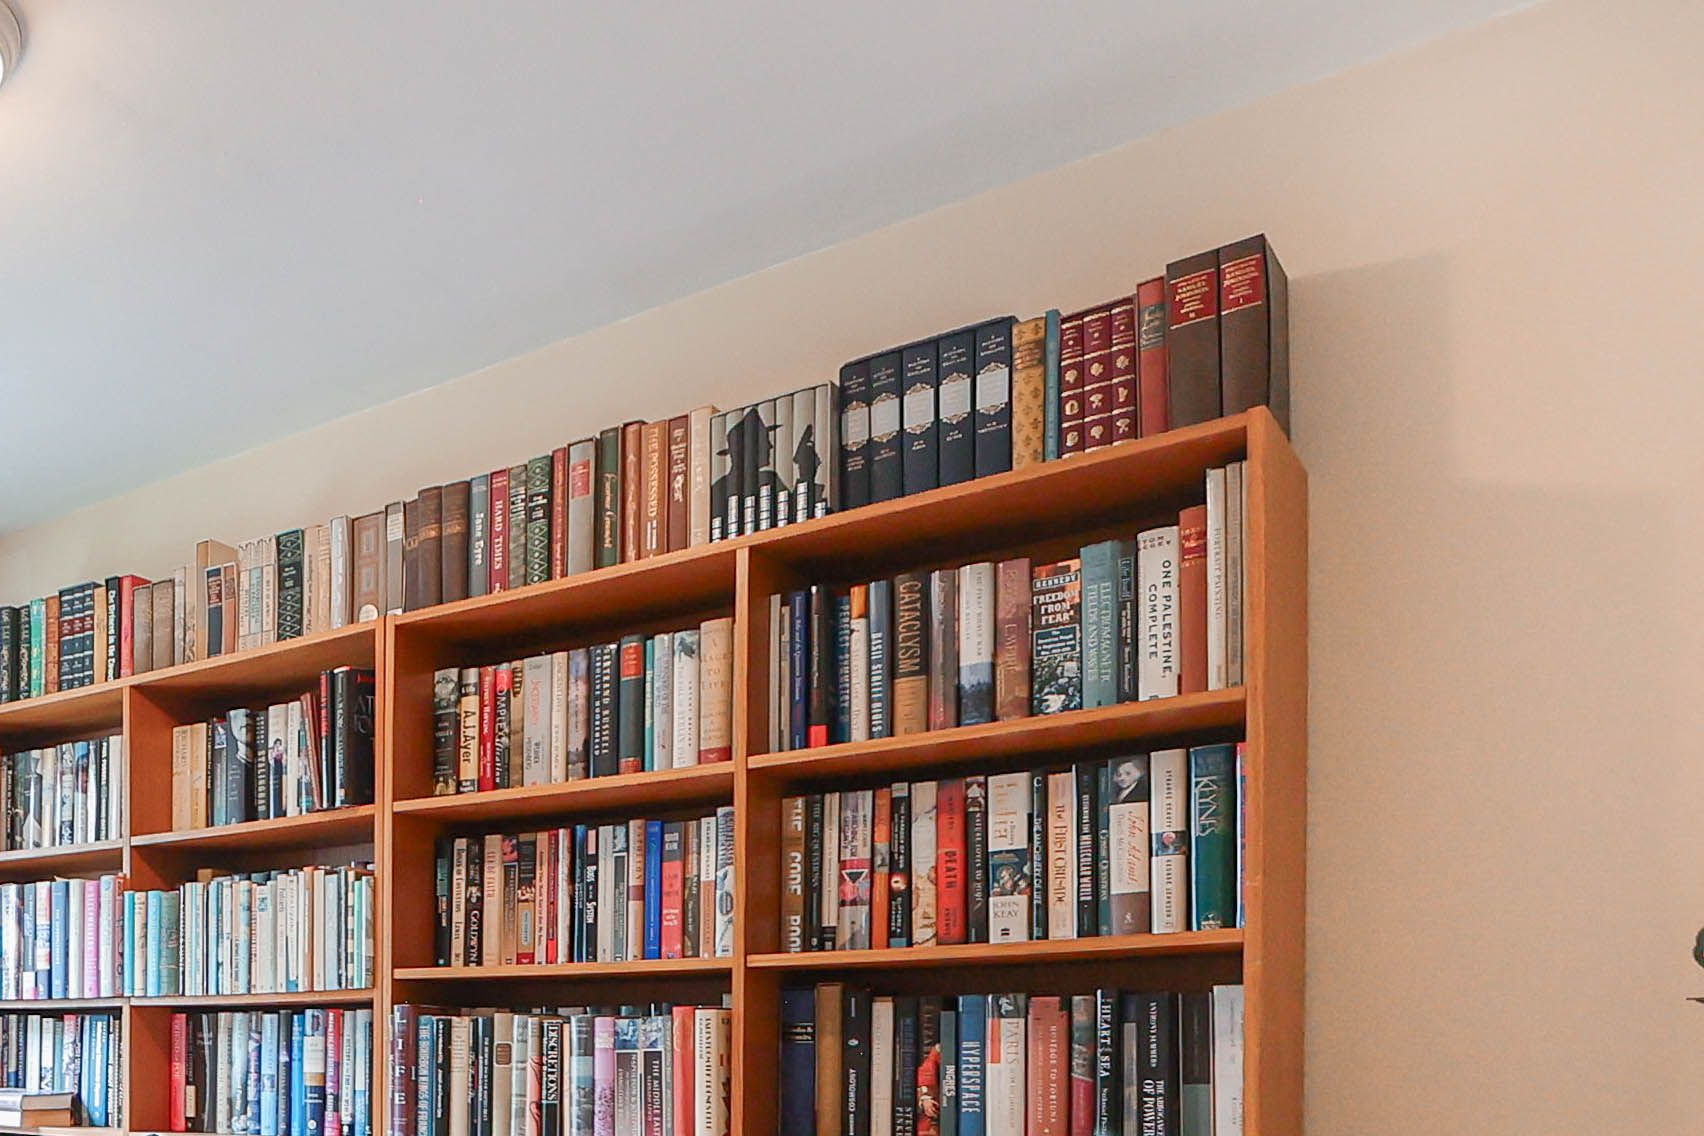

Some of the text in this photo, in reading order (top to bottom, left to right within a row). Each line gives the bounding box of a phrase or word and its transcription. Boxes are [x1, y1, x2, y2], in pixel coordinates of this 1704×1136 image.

[648, 428, 659, 517] THE POSSESSED
[474, 512, 484, 565] Jane Eyre
[494, 501, 503, 569] HARD TIMES
[1033, 589, 1079, 605] FREEDOM
[1041, 600, 1071, 614] FROM
[1041, 612, 1071, 625] FEAR
[1149, 584, 1158, 660] COMPLETE
[1162, 560, 1172, 679] ONE PALESTINE,
[870, 632, 883, 660] BASIL
[898, 581, 922, 673] CATACLYSM
[602, 710, 611, 755] RUSSELL
[257, 750, 266, 812] STALINGRAD
[944, 850, 958, 889] DEATH
[469, 911, 480, 962] GOLDWYN
[586, 901, 597, 924] SYSTEM
[546, 1025, 559, 1100] DISCRETIONS
[1006, 1021, 1020, 1065] PARIS
[1099, 1004, 1112, 1077] HEART SEA
[1143, 1080, 1155, 1136] OF POWER
[1156, 1080, 1164, 1093] THE
